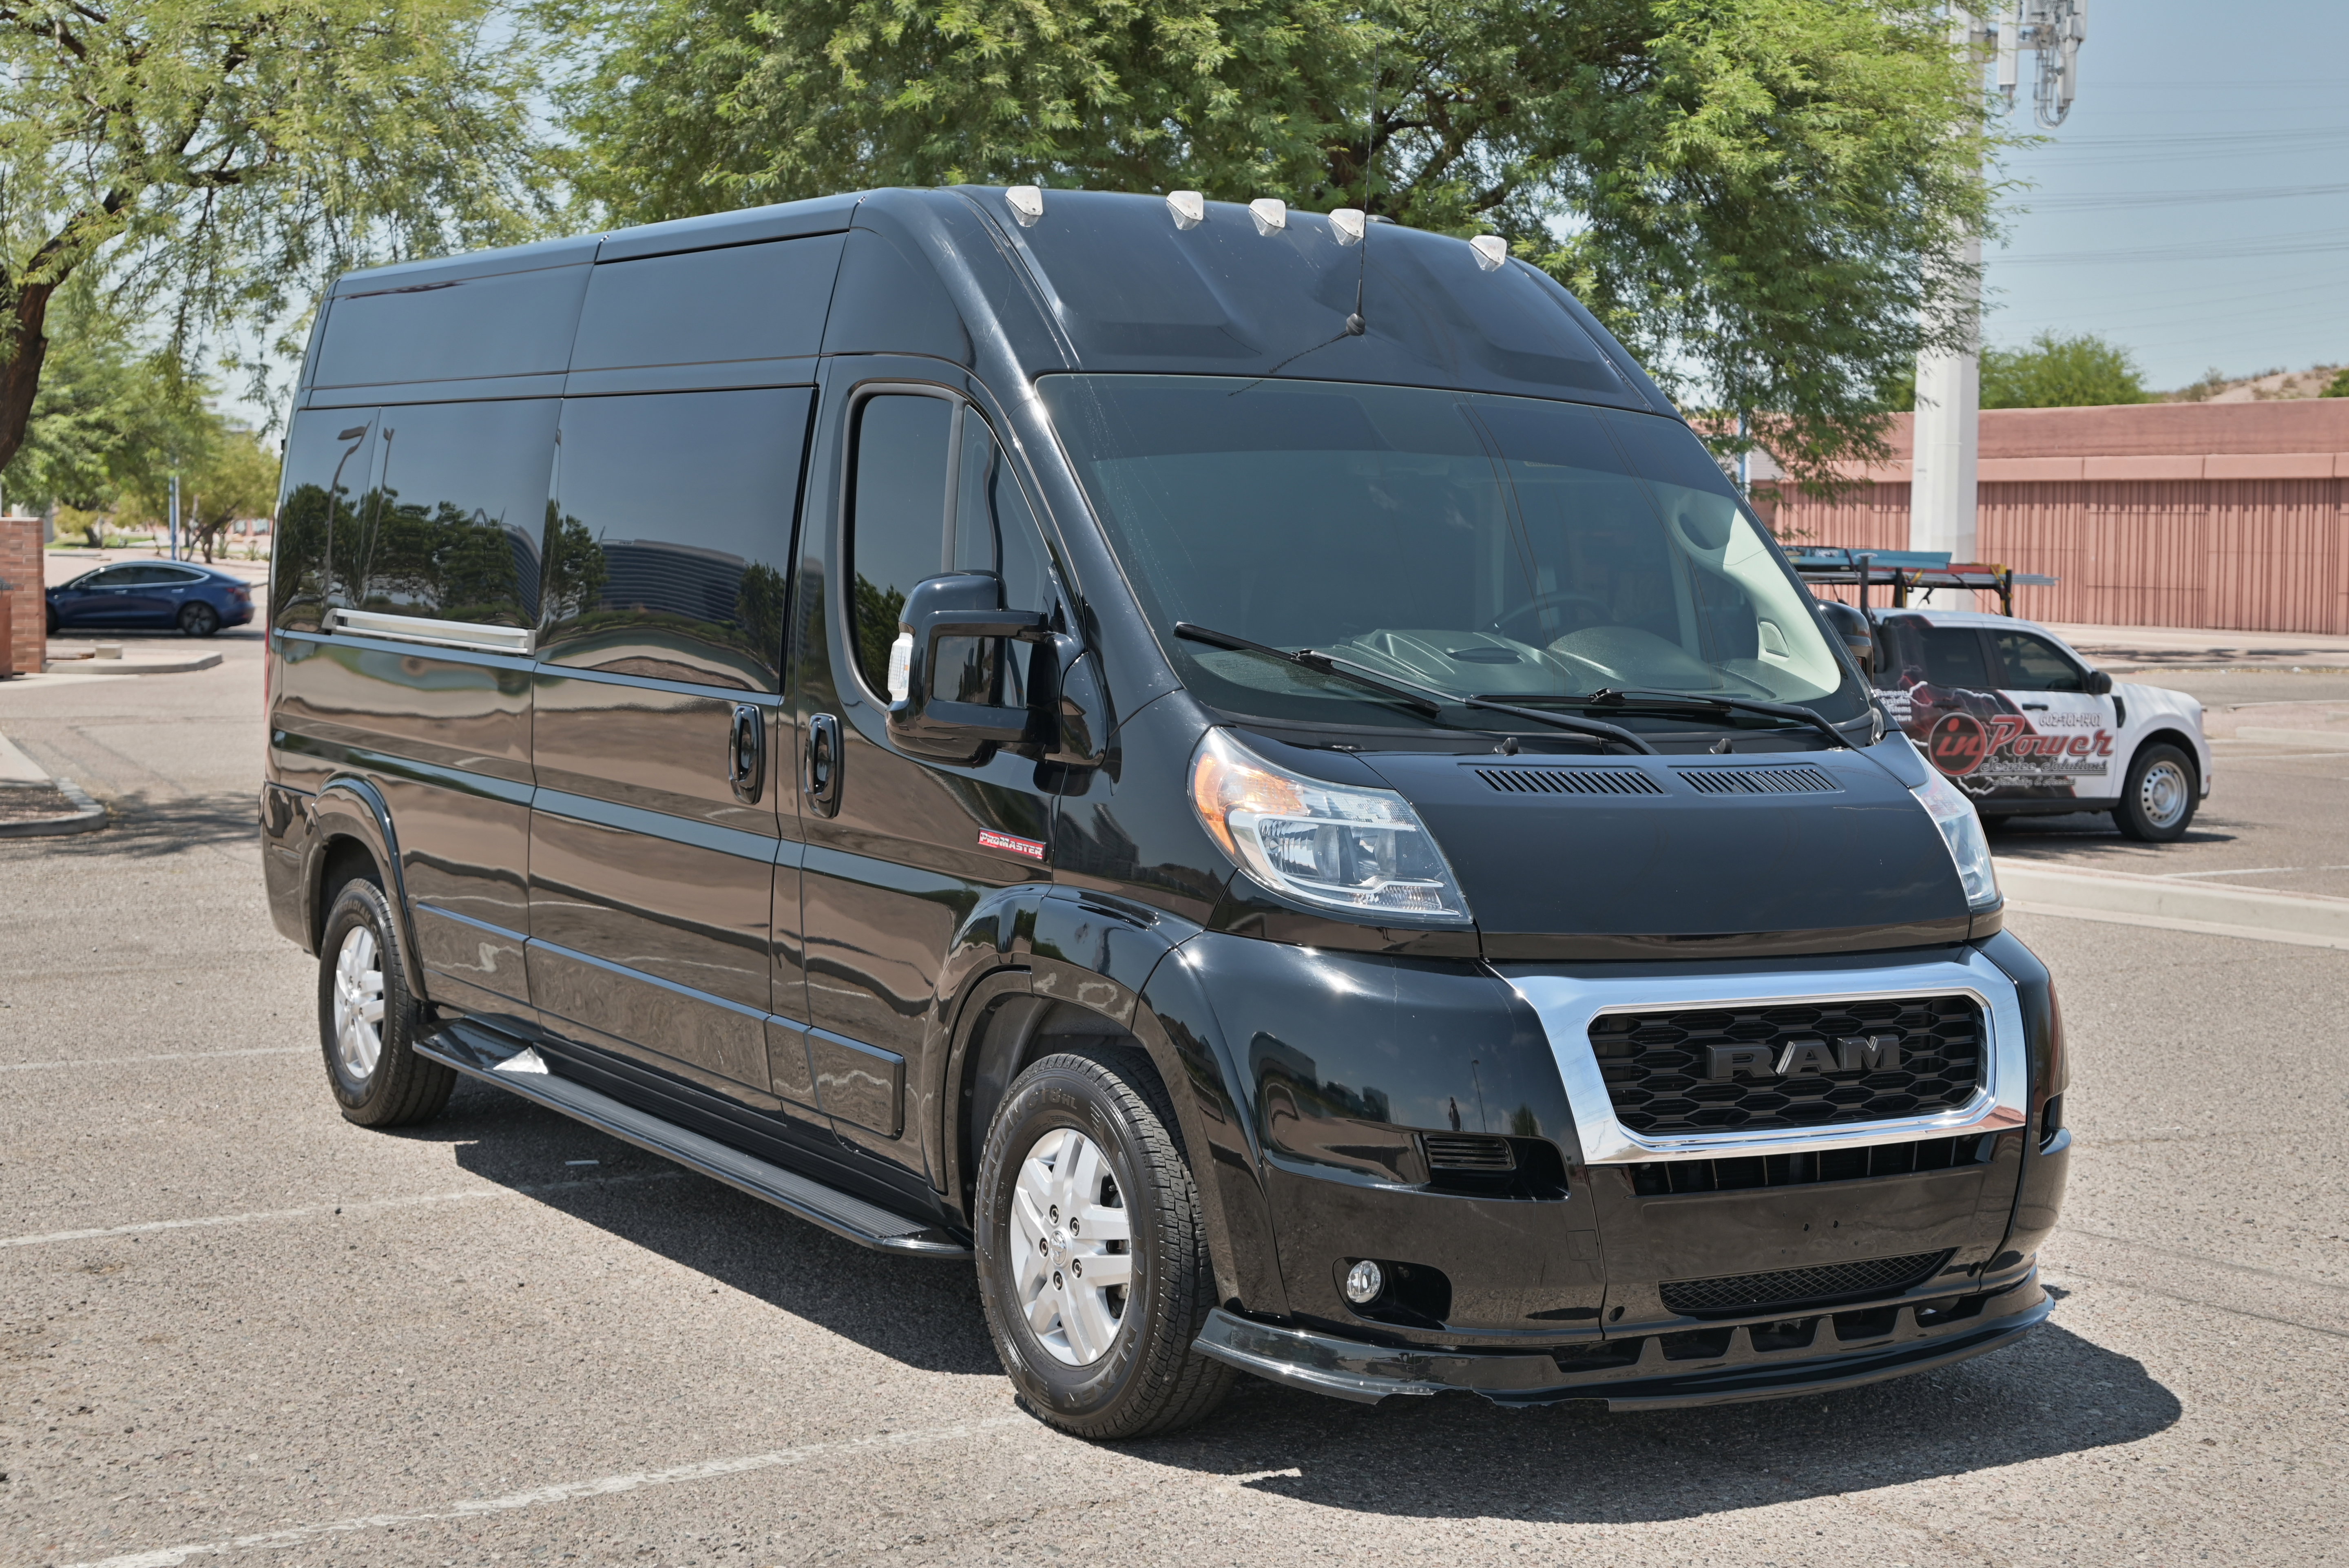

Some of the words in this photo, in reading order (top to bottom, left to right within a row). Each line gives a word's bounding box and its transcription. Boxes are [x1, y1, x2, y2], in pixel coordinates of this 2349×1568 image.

[1980, 756, 2037, 772] Service
[2041, 755, 2108, 772] Solutions
[1706, 1034, 1900, 1079] RAM
[1064, 1323, 1137, 1409] NEXEN
